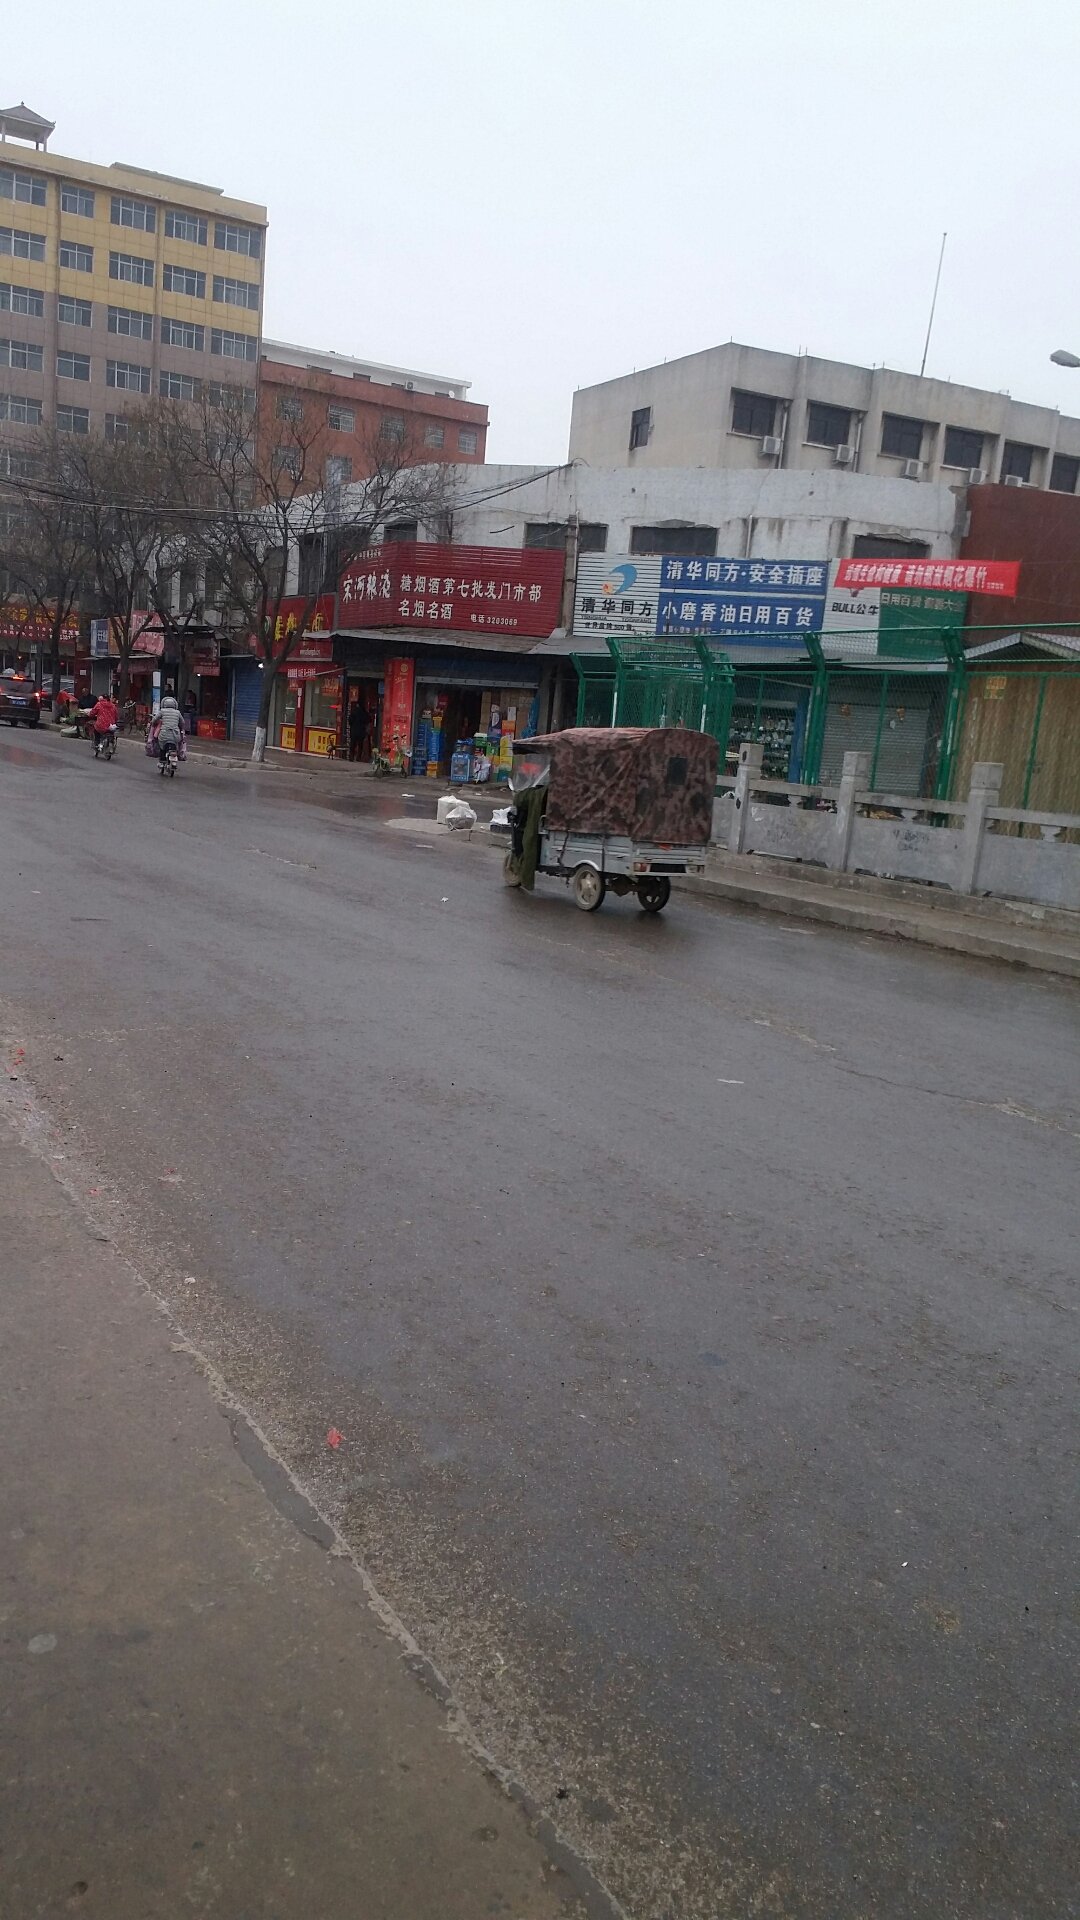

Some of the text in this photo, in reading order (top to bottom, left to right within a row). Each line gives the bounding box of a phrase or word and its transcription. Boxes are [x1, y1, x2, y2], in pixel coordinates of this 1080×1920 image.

[399, 573, 543, 603] 糖烟酒第七批发门市部
[398, 598, 455, 621] 名烟名酒
[470, 613, 486, 624] 电话
[580, 597, 655, 617] 清华同方
[661, 601, 815, 627] 小磨香油日用百货
